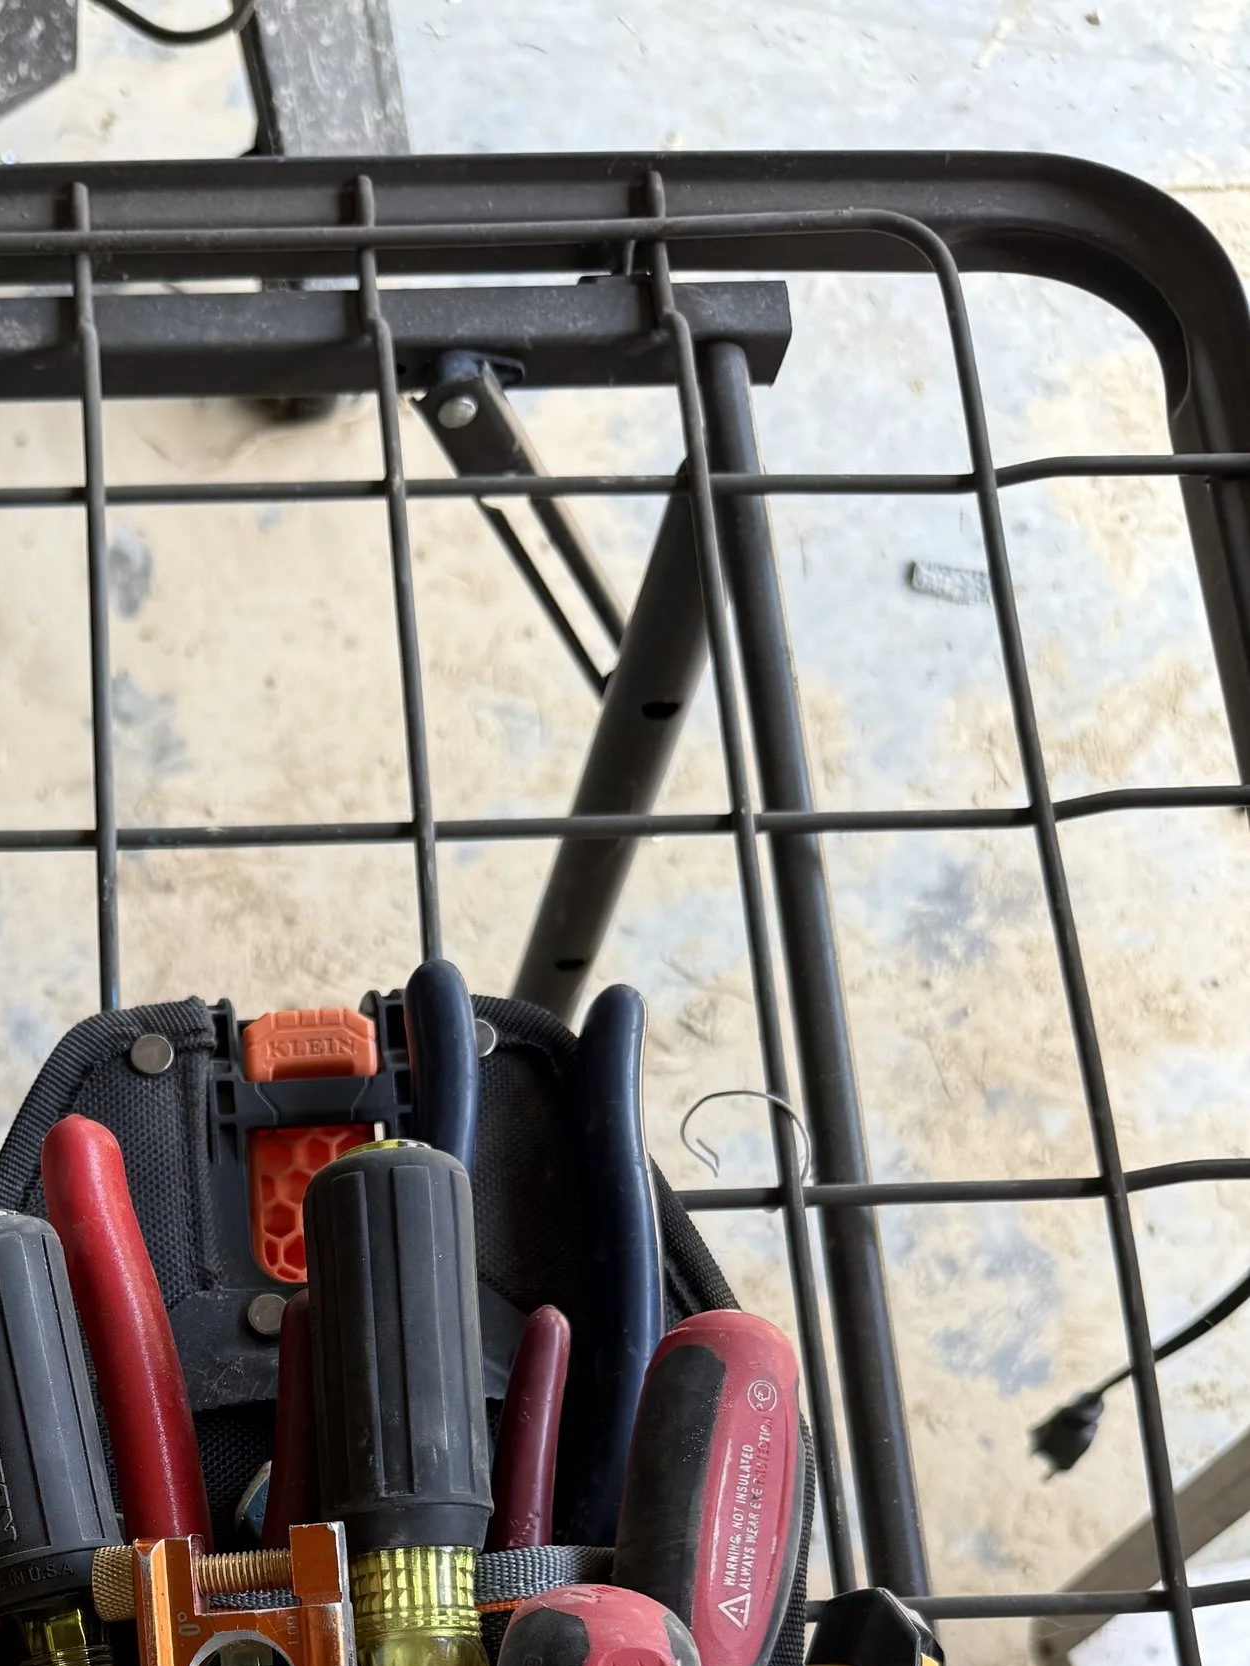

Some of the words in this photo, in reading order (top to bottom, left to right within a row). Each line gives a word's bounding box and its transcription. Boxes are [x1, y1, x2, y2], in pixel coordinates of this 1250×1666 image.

[735, 1444, 754, 1504] INSULATED
[732, 1507, 745, 1529] NOT
[744, 1513, 759, 1544] WEAR
[738, 1547, 756, 1591] ALWAYS
